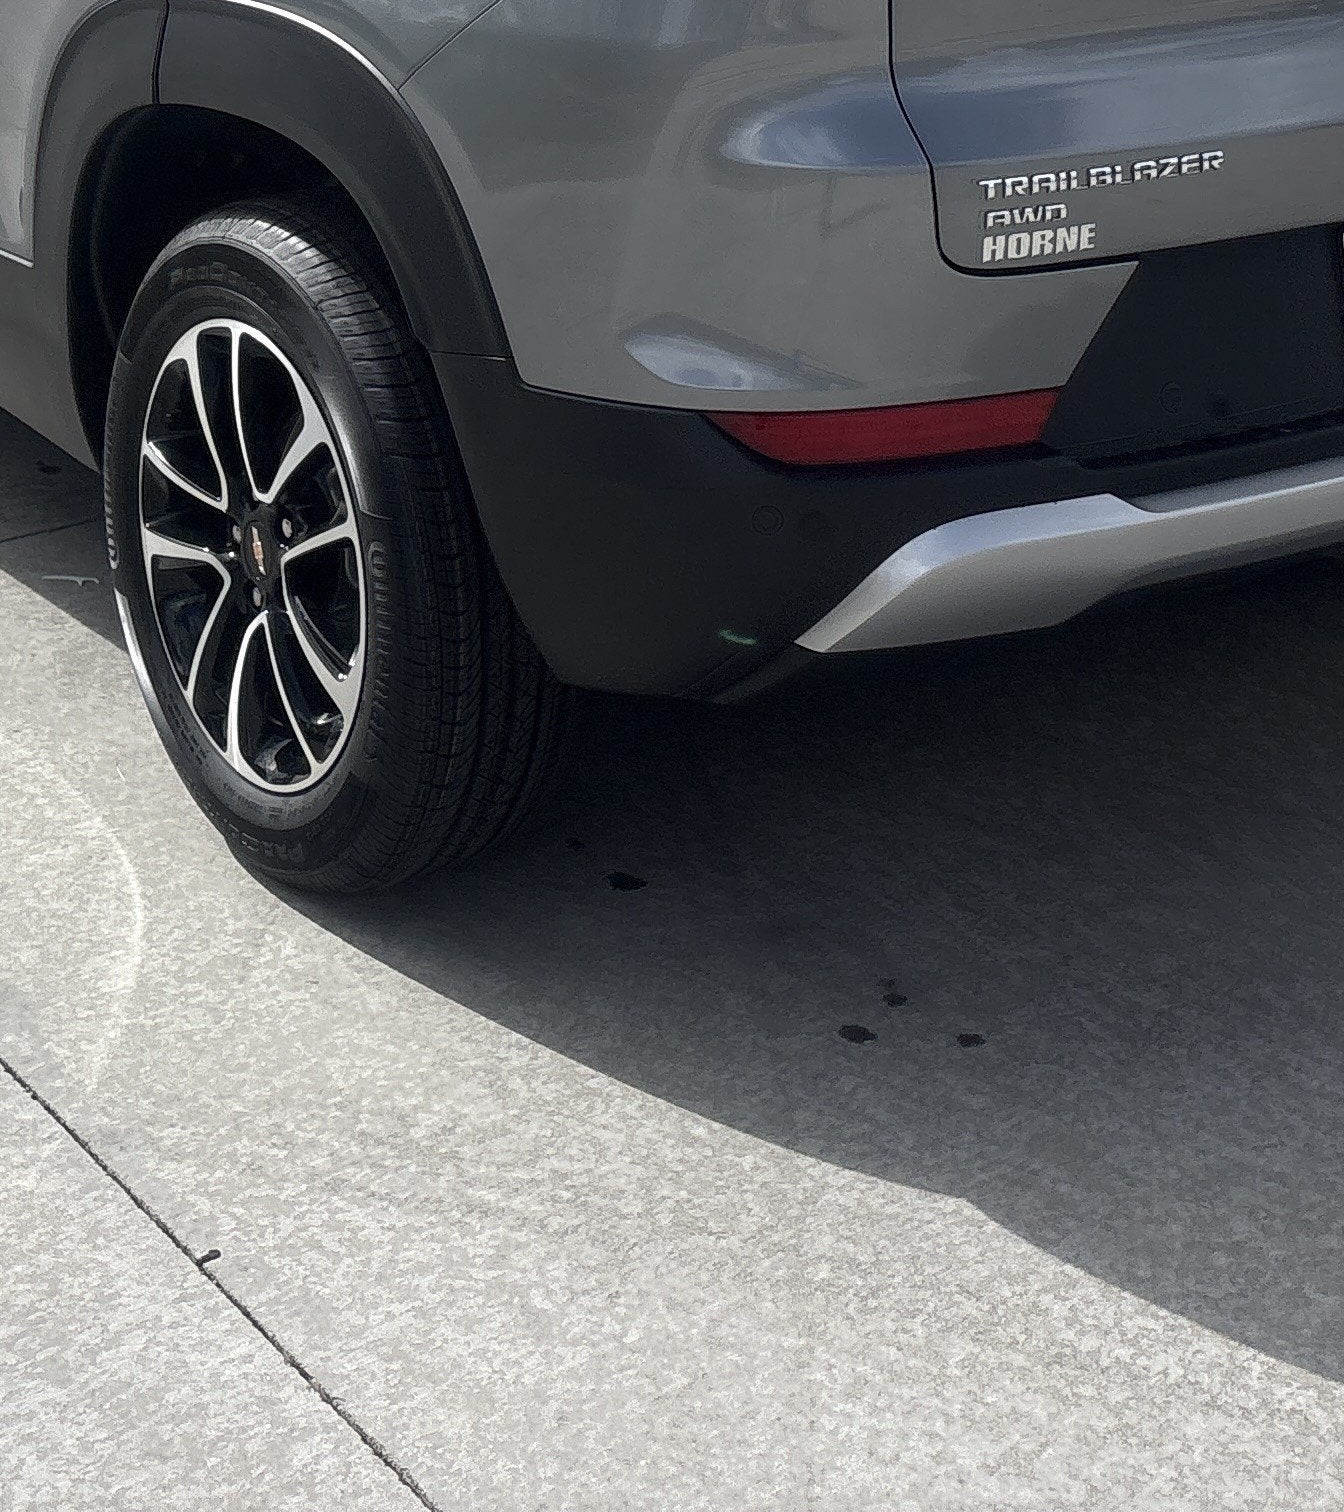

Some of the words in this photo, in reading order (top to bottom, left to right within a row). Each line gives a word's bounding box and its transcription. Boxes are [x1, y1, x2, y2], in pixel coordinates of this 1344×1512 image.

[979, 149, 1225, 200] TRAILBLAZER
[985, 203, 1068, 230] AWD
[981, 222, 1097, 264] HORNE
